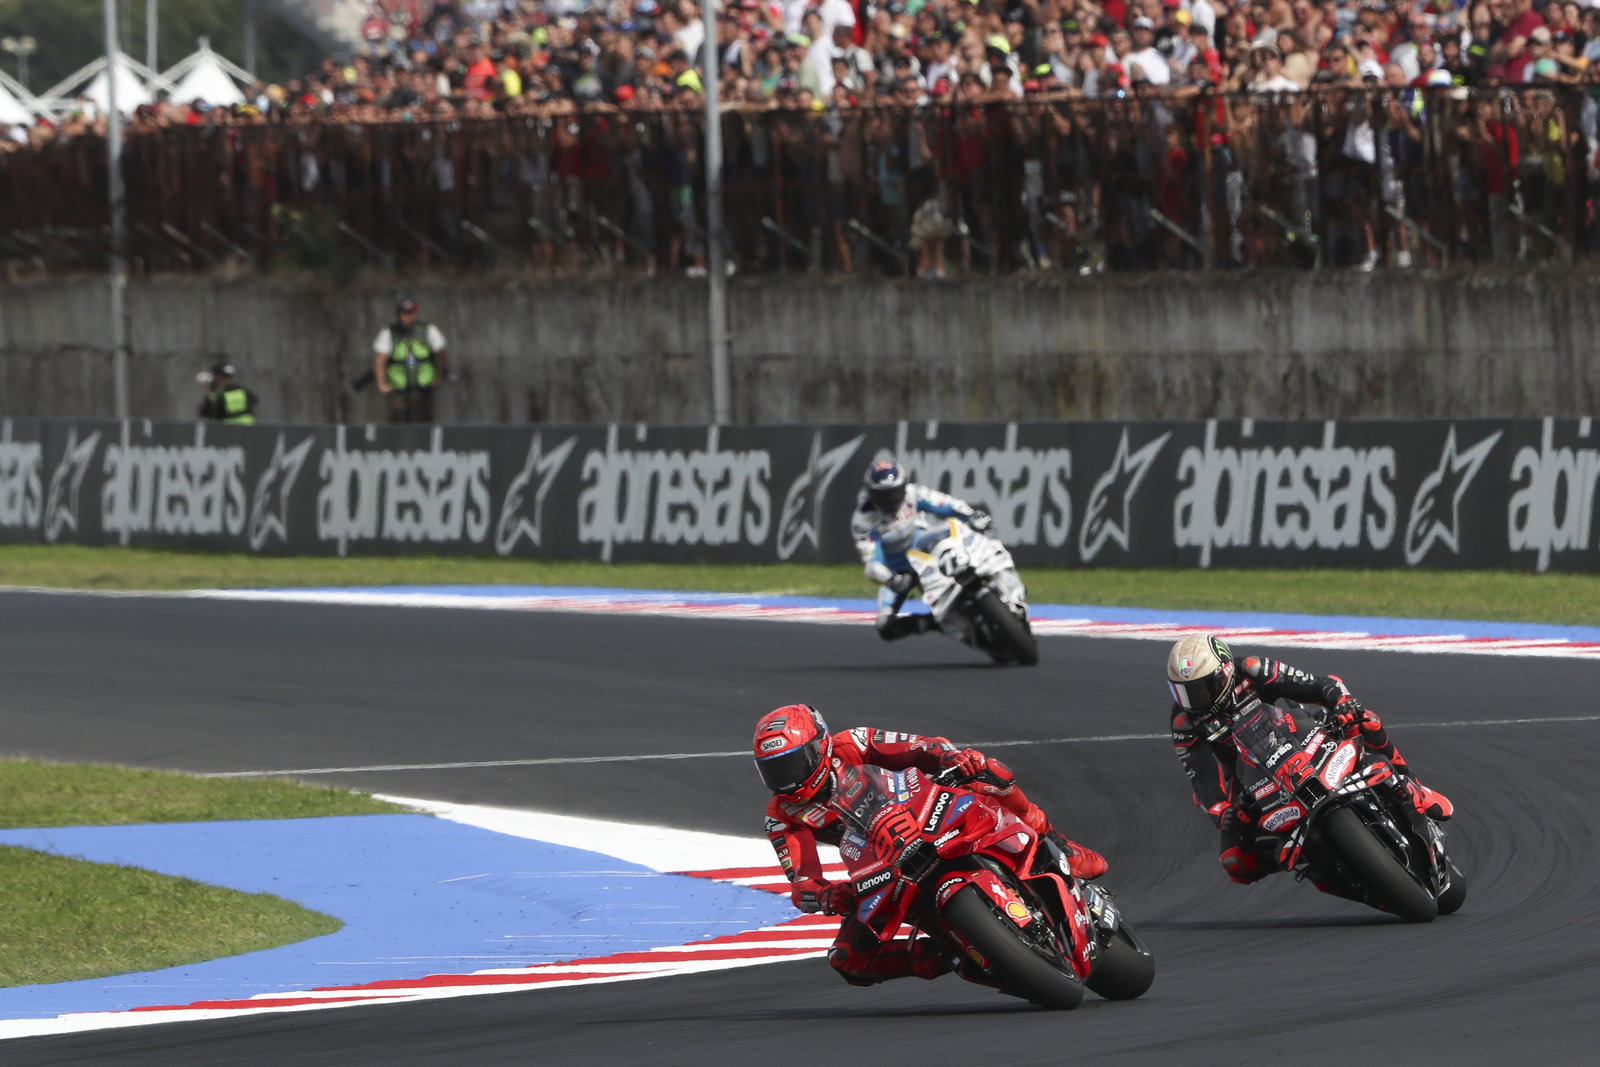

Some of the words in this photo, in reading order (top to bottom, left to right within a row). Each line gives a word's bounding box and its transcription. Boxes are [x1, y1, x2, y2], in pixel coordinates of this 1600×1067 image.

[762, 740, 783, 751] SHOEI
[1265, 743, 1293, 768] aprilia
[924, 792, 950, 831] Lenovo
[957, 800, 973, 813] TIM
[857, 871, 892, 893] Lenovo
[868, 894, 882, 910] TIM
